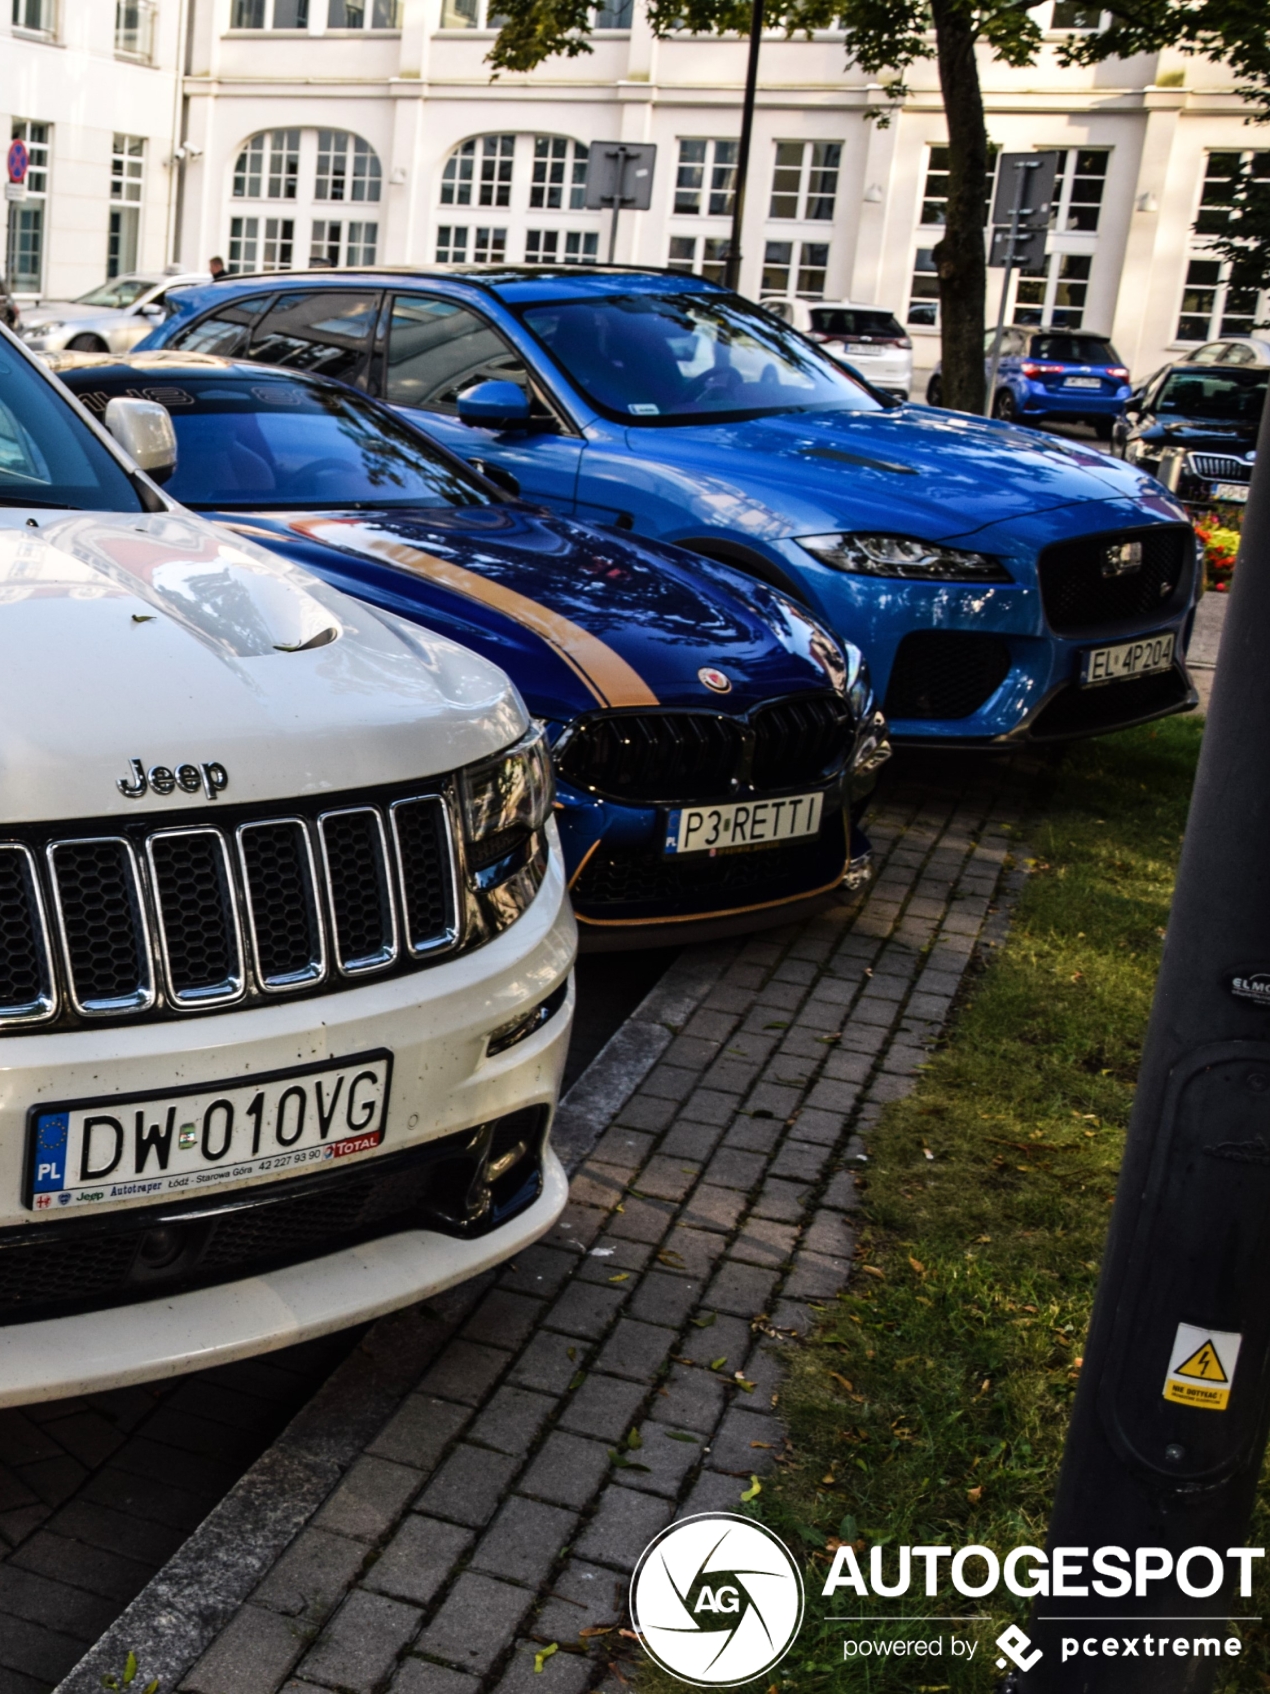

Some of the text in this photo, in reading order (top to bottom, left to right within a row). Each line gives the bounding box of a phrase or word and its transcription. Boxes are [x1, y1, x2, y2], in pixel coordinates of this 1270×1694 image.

[1092, 637, 1173, 679] EL 4P204
[116, 756, 228, 800] Jeep
[684, 797, 814, 848] P3 RETTI
[337, 1137, 377, 1155] TOTAL
[37, 1162, 61, 1181] PL
[196, 1171, 230, 1184] Starowa
[232, 1166, 253, 1177] Góra
[76, 1190, 104, 1202] Jeep
[110, 1181, 162, 1197] Autotraper
